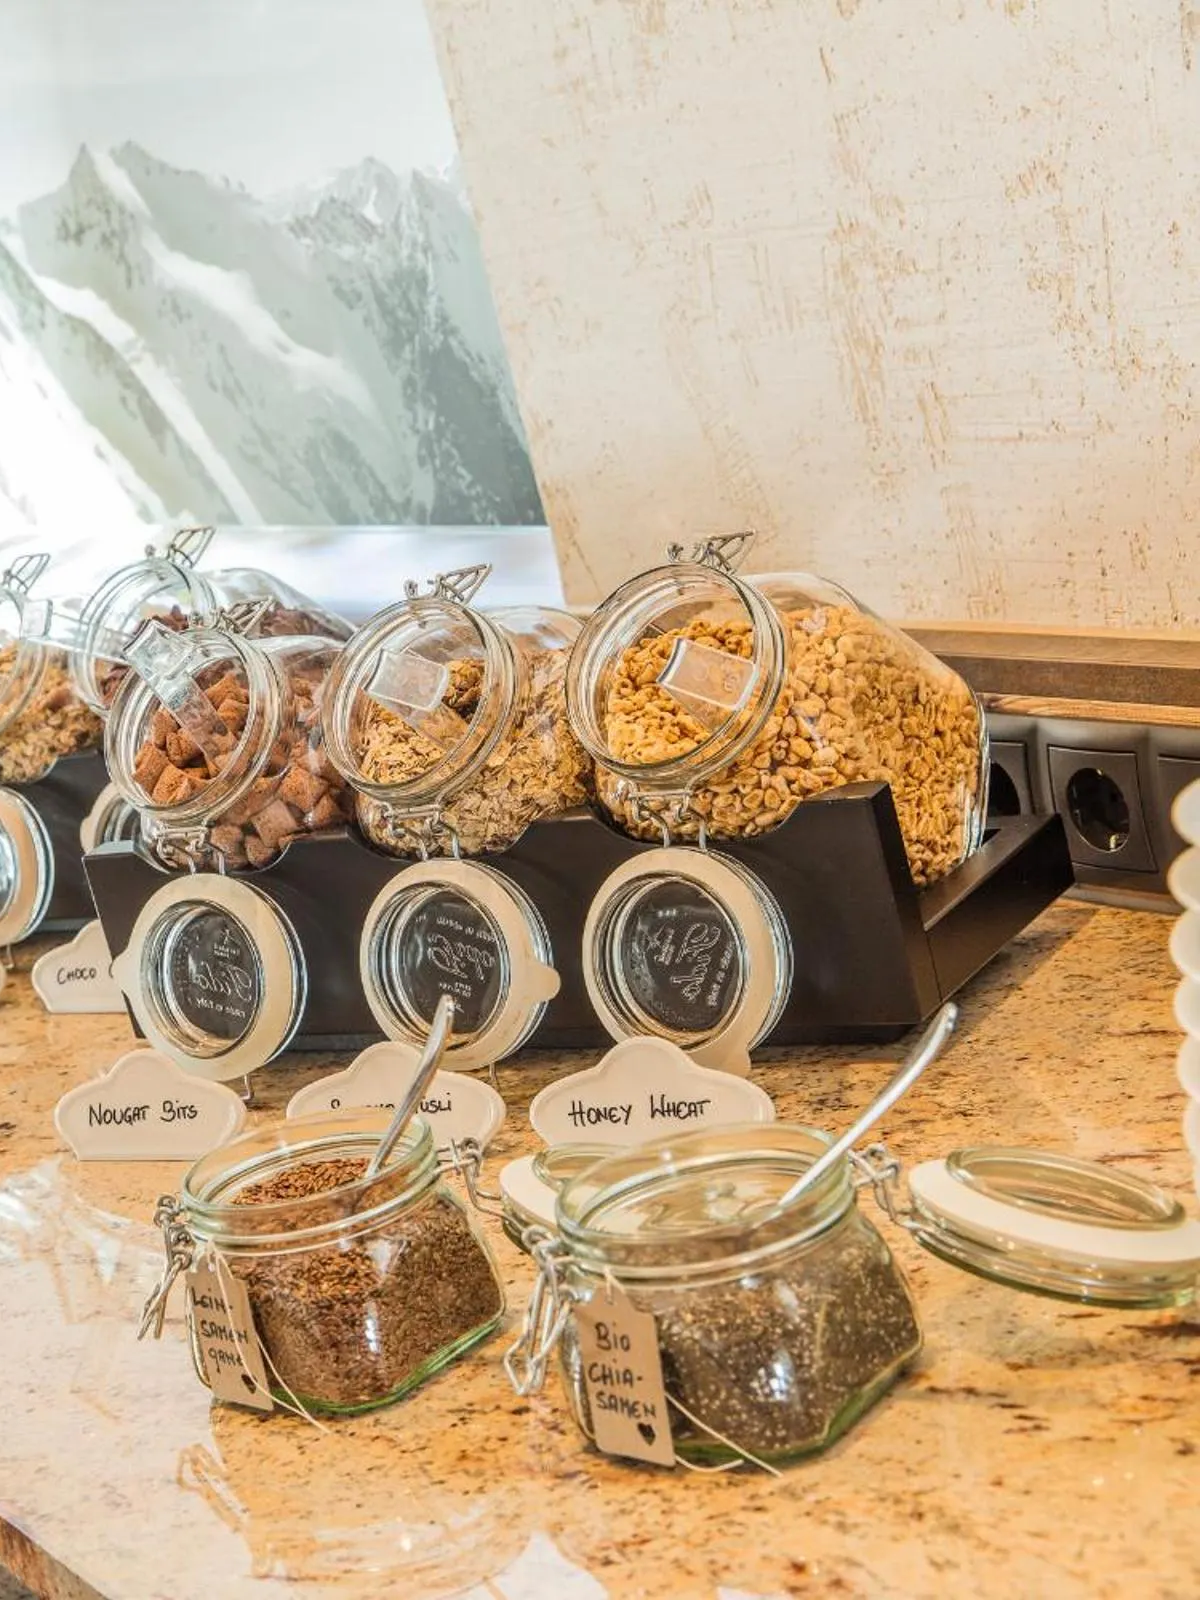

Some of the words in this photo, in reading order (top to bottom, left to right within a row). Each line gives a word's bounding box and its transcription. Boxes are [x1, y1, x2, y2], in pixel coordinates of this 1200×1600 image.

[56, 967, 98, 985] CHOCO
[88, 1102, 151, 1128] NOUGAT
[159, 1100, 199, 1123] BITS
[568, 1100, 633, 1128] HONEY
[649, 1094, 712, 1120] WHEAT
[594, 1320, 632, 1351] BIO
[595, 1391, 657, 1419] SAMEN
